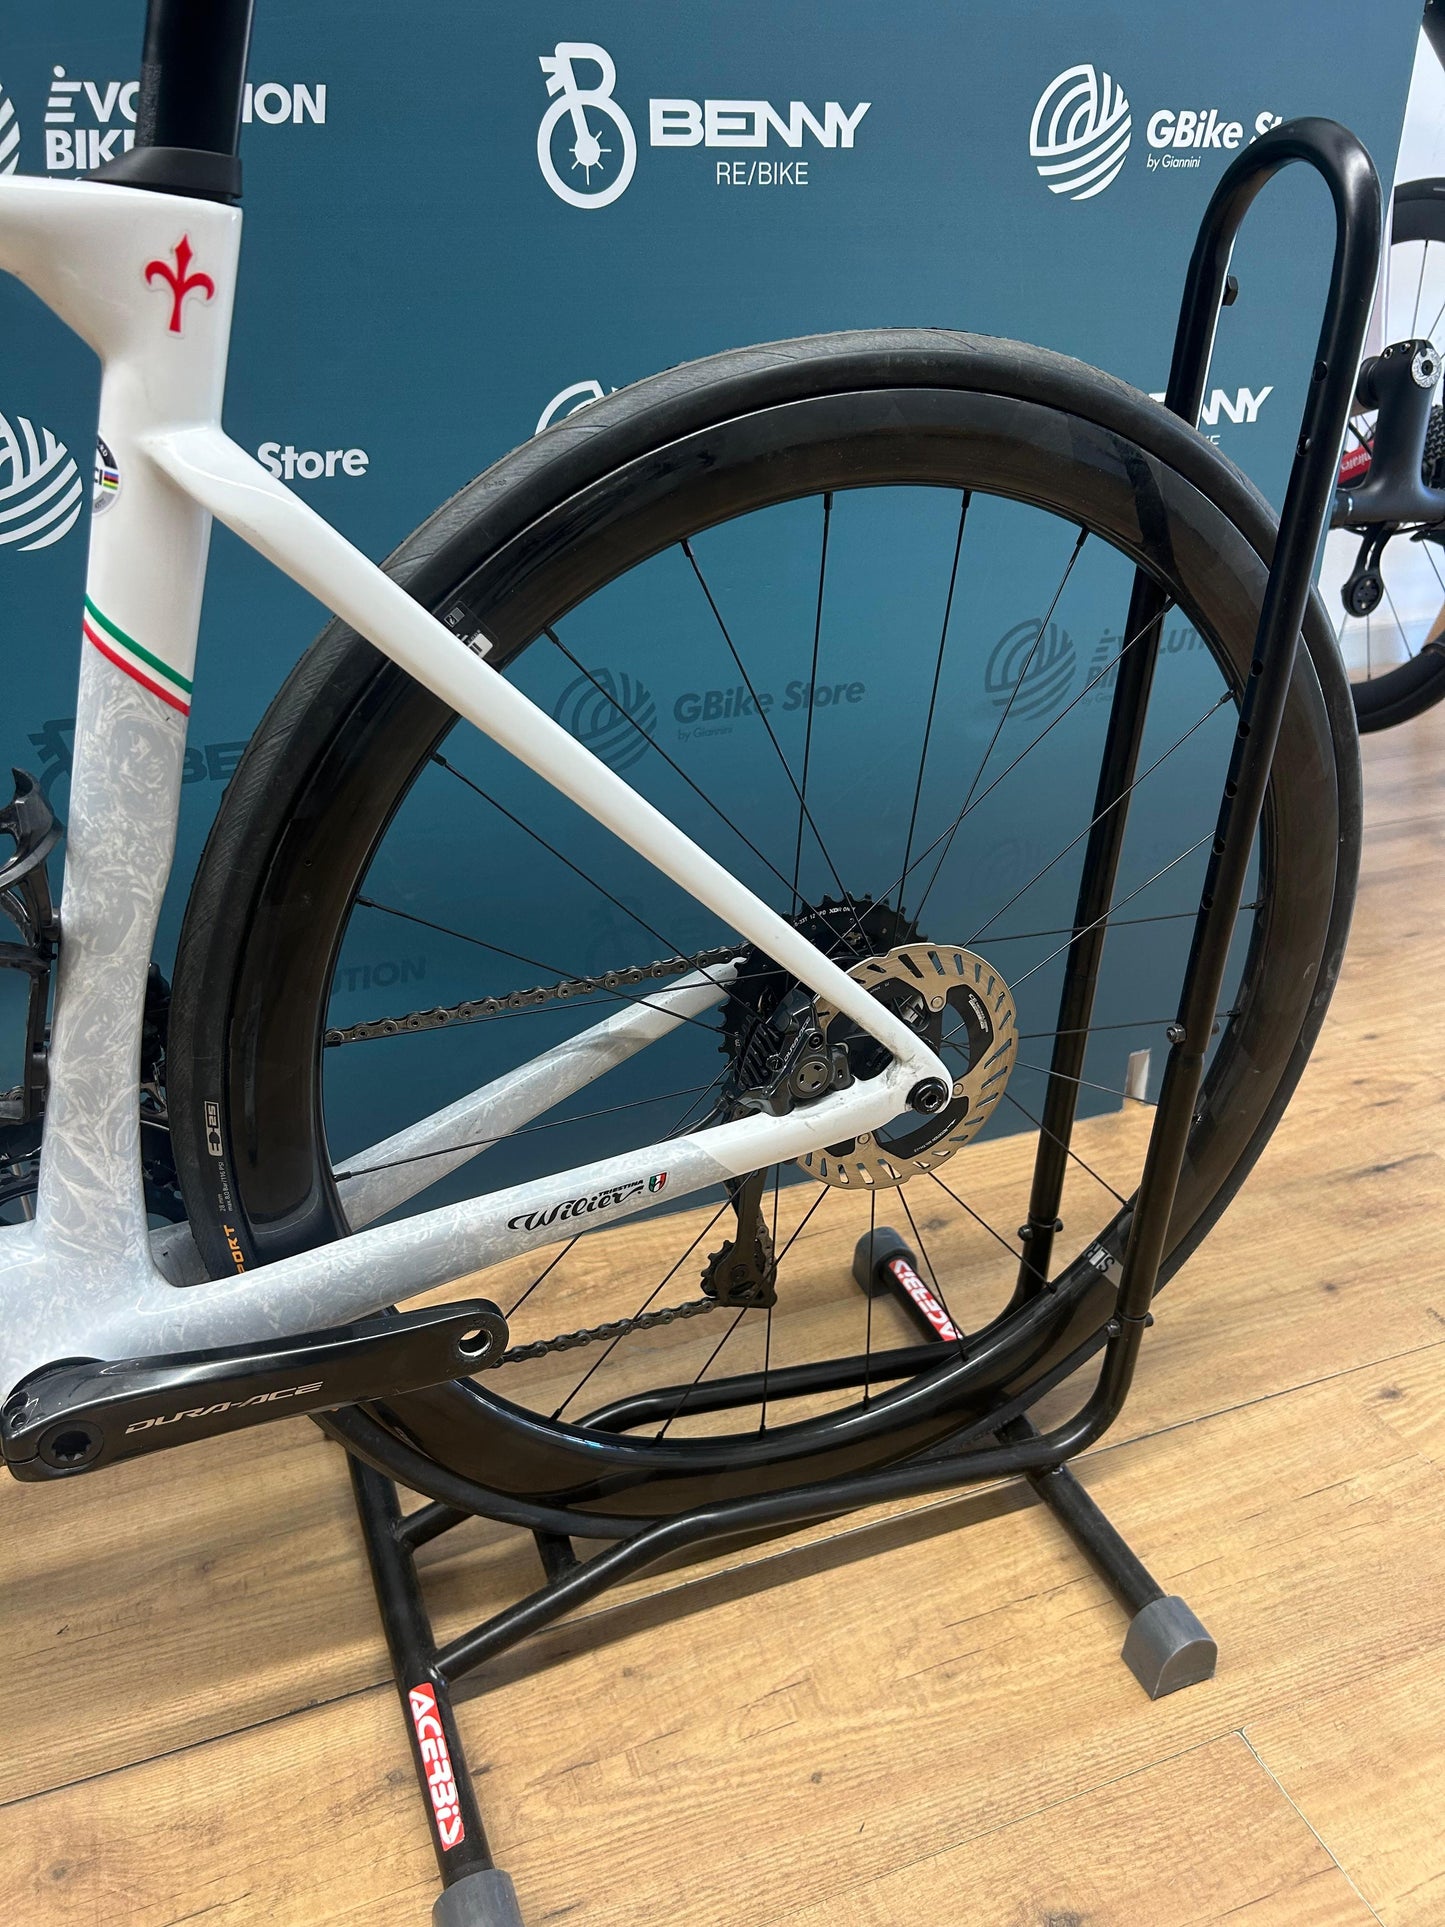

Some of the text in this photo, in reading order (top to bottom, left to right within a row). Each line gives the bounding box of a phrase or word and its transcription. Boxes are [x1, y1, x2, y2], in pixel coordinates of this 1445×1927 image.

[649, 98, 872, 148] BENNY
[1146, 109, 1244, 149] GBike
[715, 161, 809, 186] RE/BIKE
[1146, 153, 1202, 172] by Giannini
[257, 441, 370, 480] Store
[673, 681, 866, 724] GBike Store
[508, 1185, 644, 1231] Wilier
[599, 1179, 643, 1197] TRIESTINA
[125, 1381, 323, 1435] DURA-ACE
